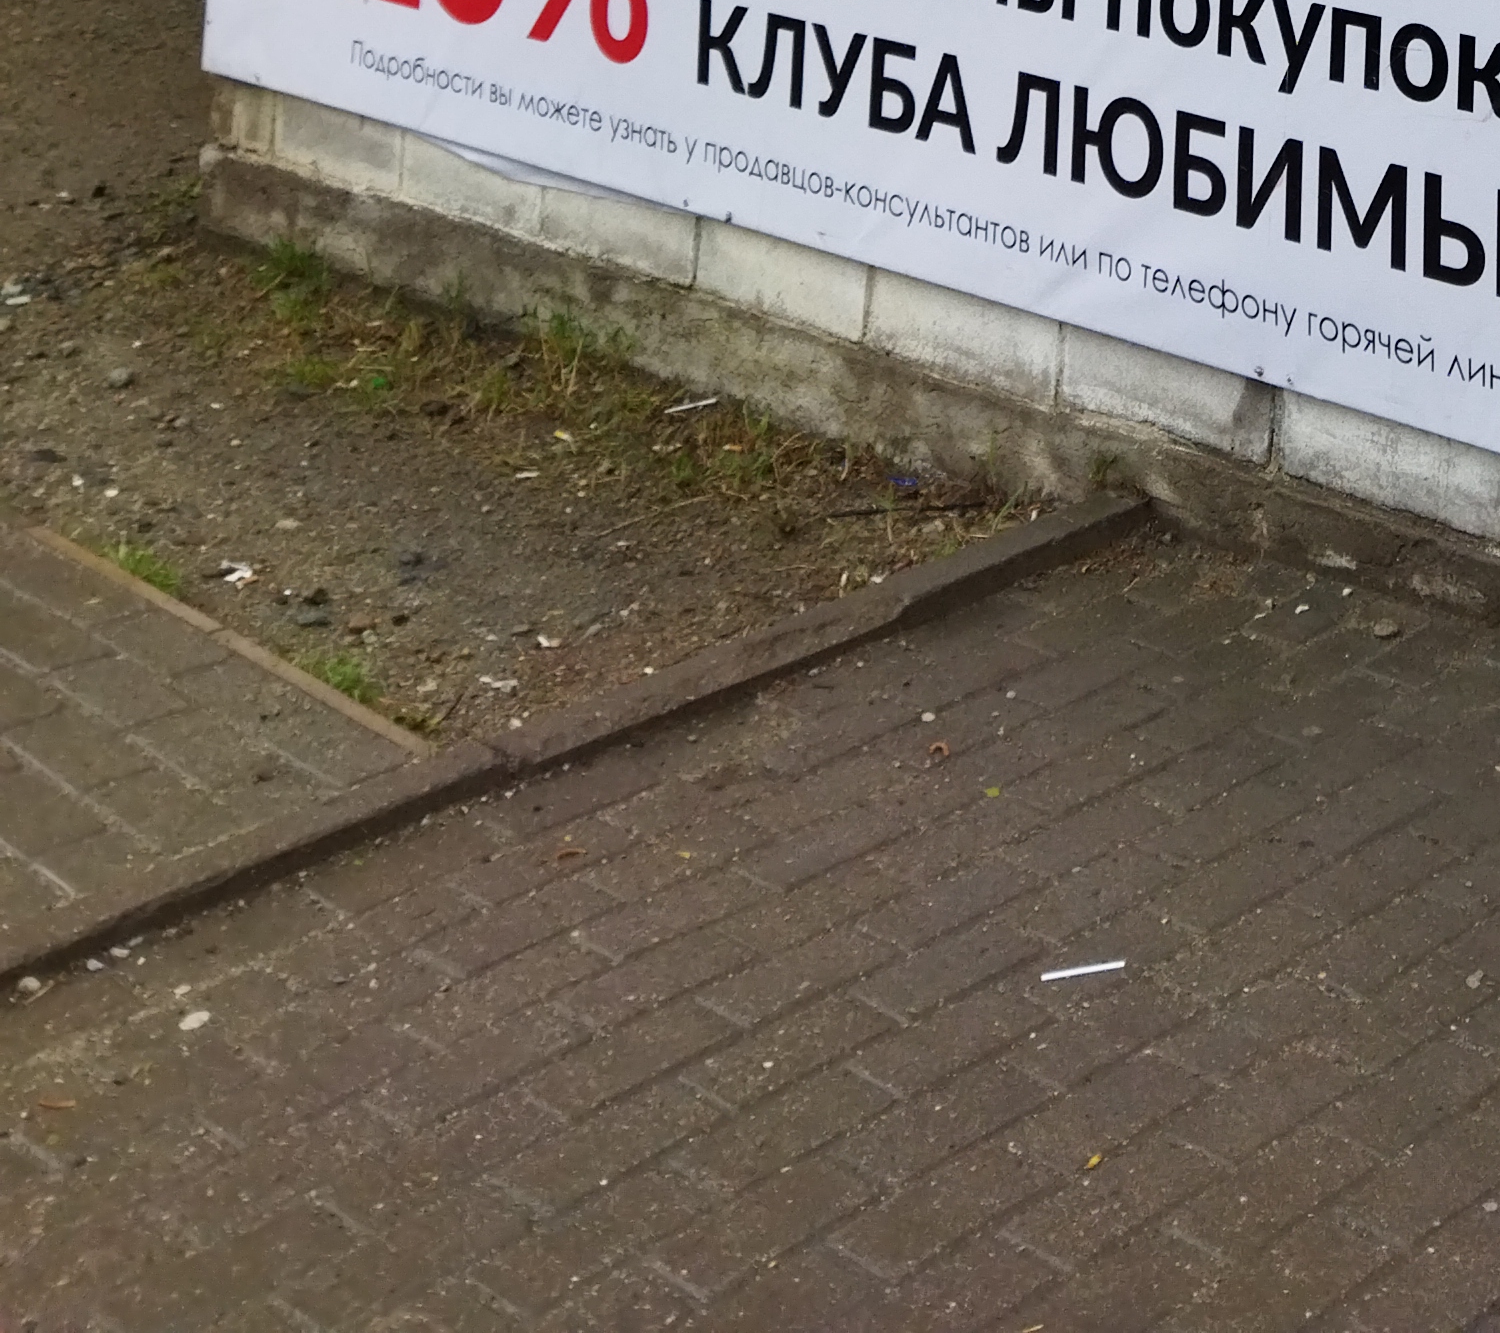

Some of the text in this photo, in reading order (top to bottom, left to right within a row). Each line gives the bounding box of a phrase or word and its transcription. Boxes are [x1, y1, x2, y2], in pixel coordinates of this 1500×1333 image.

[349, 39, 485, 104] Подробности
[488, 83, 513, 109] вы
[516, 91, 604, 133] можете
[608, 113, 679, 156] узнать
[683, 137, 701, 166] у
[703, 140, 1032, 255] продавцов-консультантов
[1037, 233, 1089, 273] или
[1098, 253, 1133, 284] по
[1140, 264, 1298, 337] телефону
[1307, 312, 1437, 373] горячей
